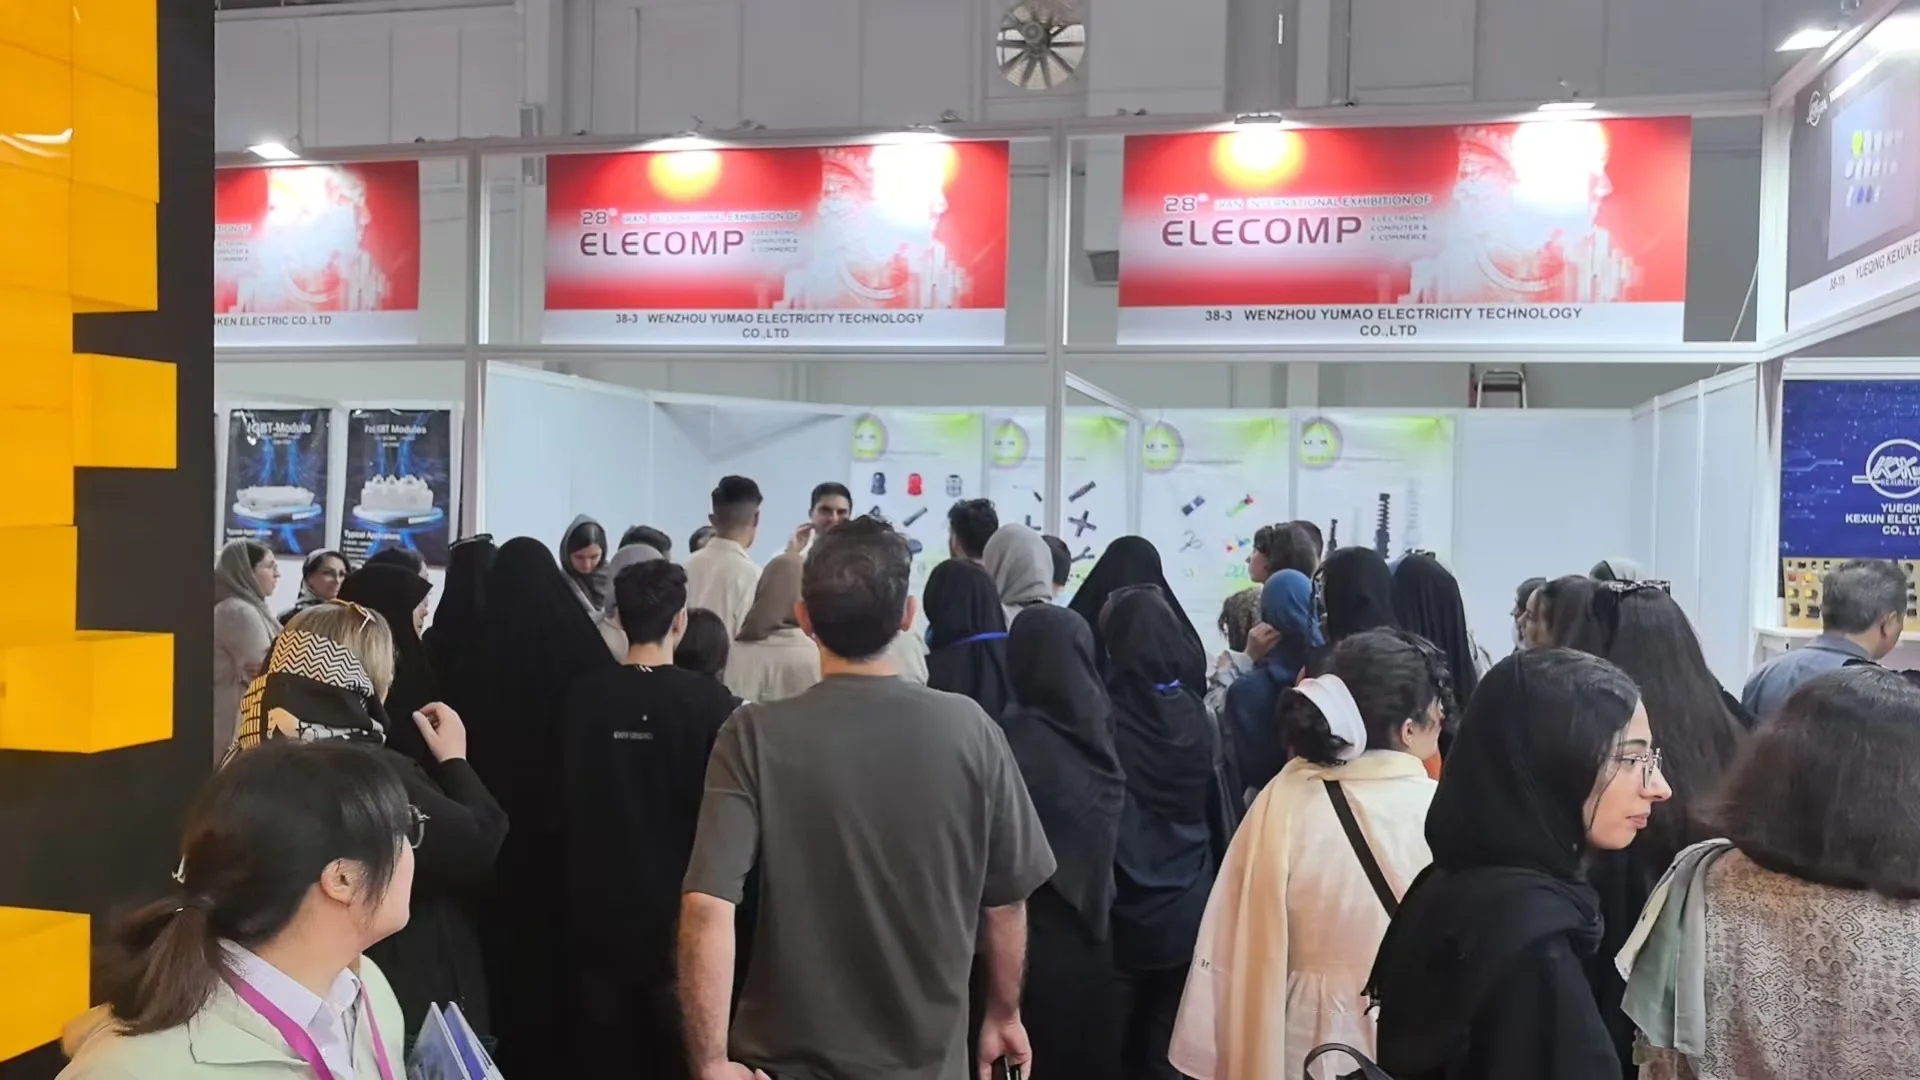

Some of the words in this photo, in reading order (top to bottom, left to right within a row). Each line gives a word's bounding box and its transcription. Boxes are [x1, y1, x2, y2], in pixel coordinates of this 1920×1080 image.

[1343, 195, 1411, 206] EXHIBITION
[1414, 194, 1428, 205] OF
[1162, 216, 1362, 246] ELECOMP
[580, 230, 744, 255] ELECOMP
[616, 314, 638, 324] 38-3
[648, 314, 707, 324] WENZHOU
[710, 313, 754, 324] YUMAO
[757, 313, 834, 324] ELECTRICITY
[838, 313, 924, 324] TECHNOLOGY
[1205, 309, 1232, 321] 38-3
[1244, 308, 1316, 321] WENZHOU
[1321, 308, 1373, 320] YUMAO
[1377, 307, 1473, 320] ELECTRICITY
[1477, 307, 1582, 319] TECHNOLOGY
[214, 316, 236, 326] KEN
[240, 316, 288, 326] ELECTRIC
[1845, 514, 1884, 524] KEXUN
[1882, 525, 1906, 536] CO.,
